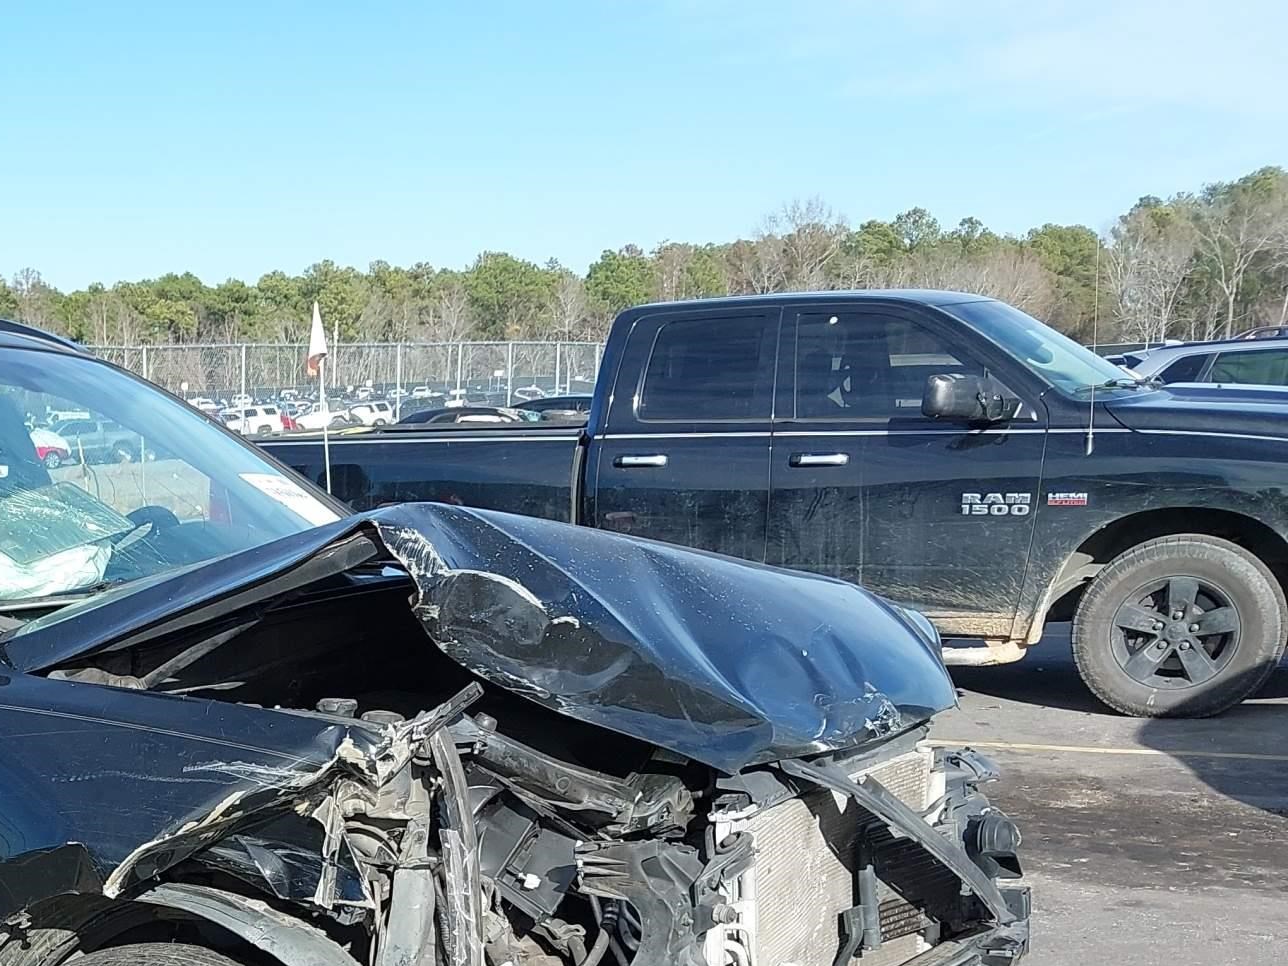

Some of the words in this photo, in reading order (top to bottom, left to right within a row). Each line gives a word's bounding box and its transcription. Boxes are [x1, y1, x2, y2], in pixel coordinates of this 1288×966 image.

[962, 493, 1031, 504] RAM
[1047, 492, 1088, 501] HEMI
[961, 504, 1030, 516] 1500
